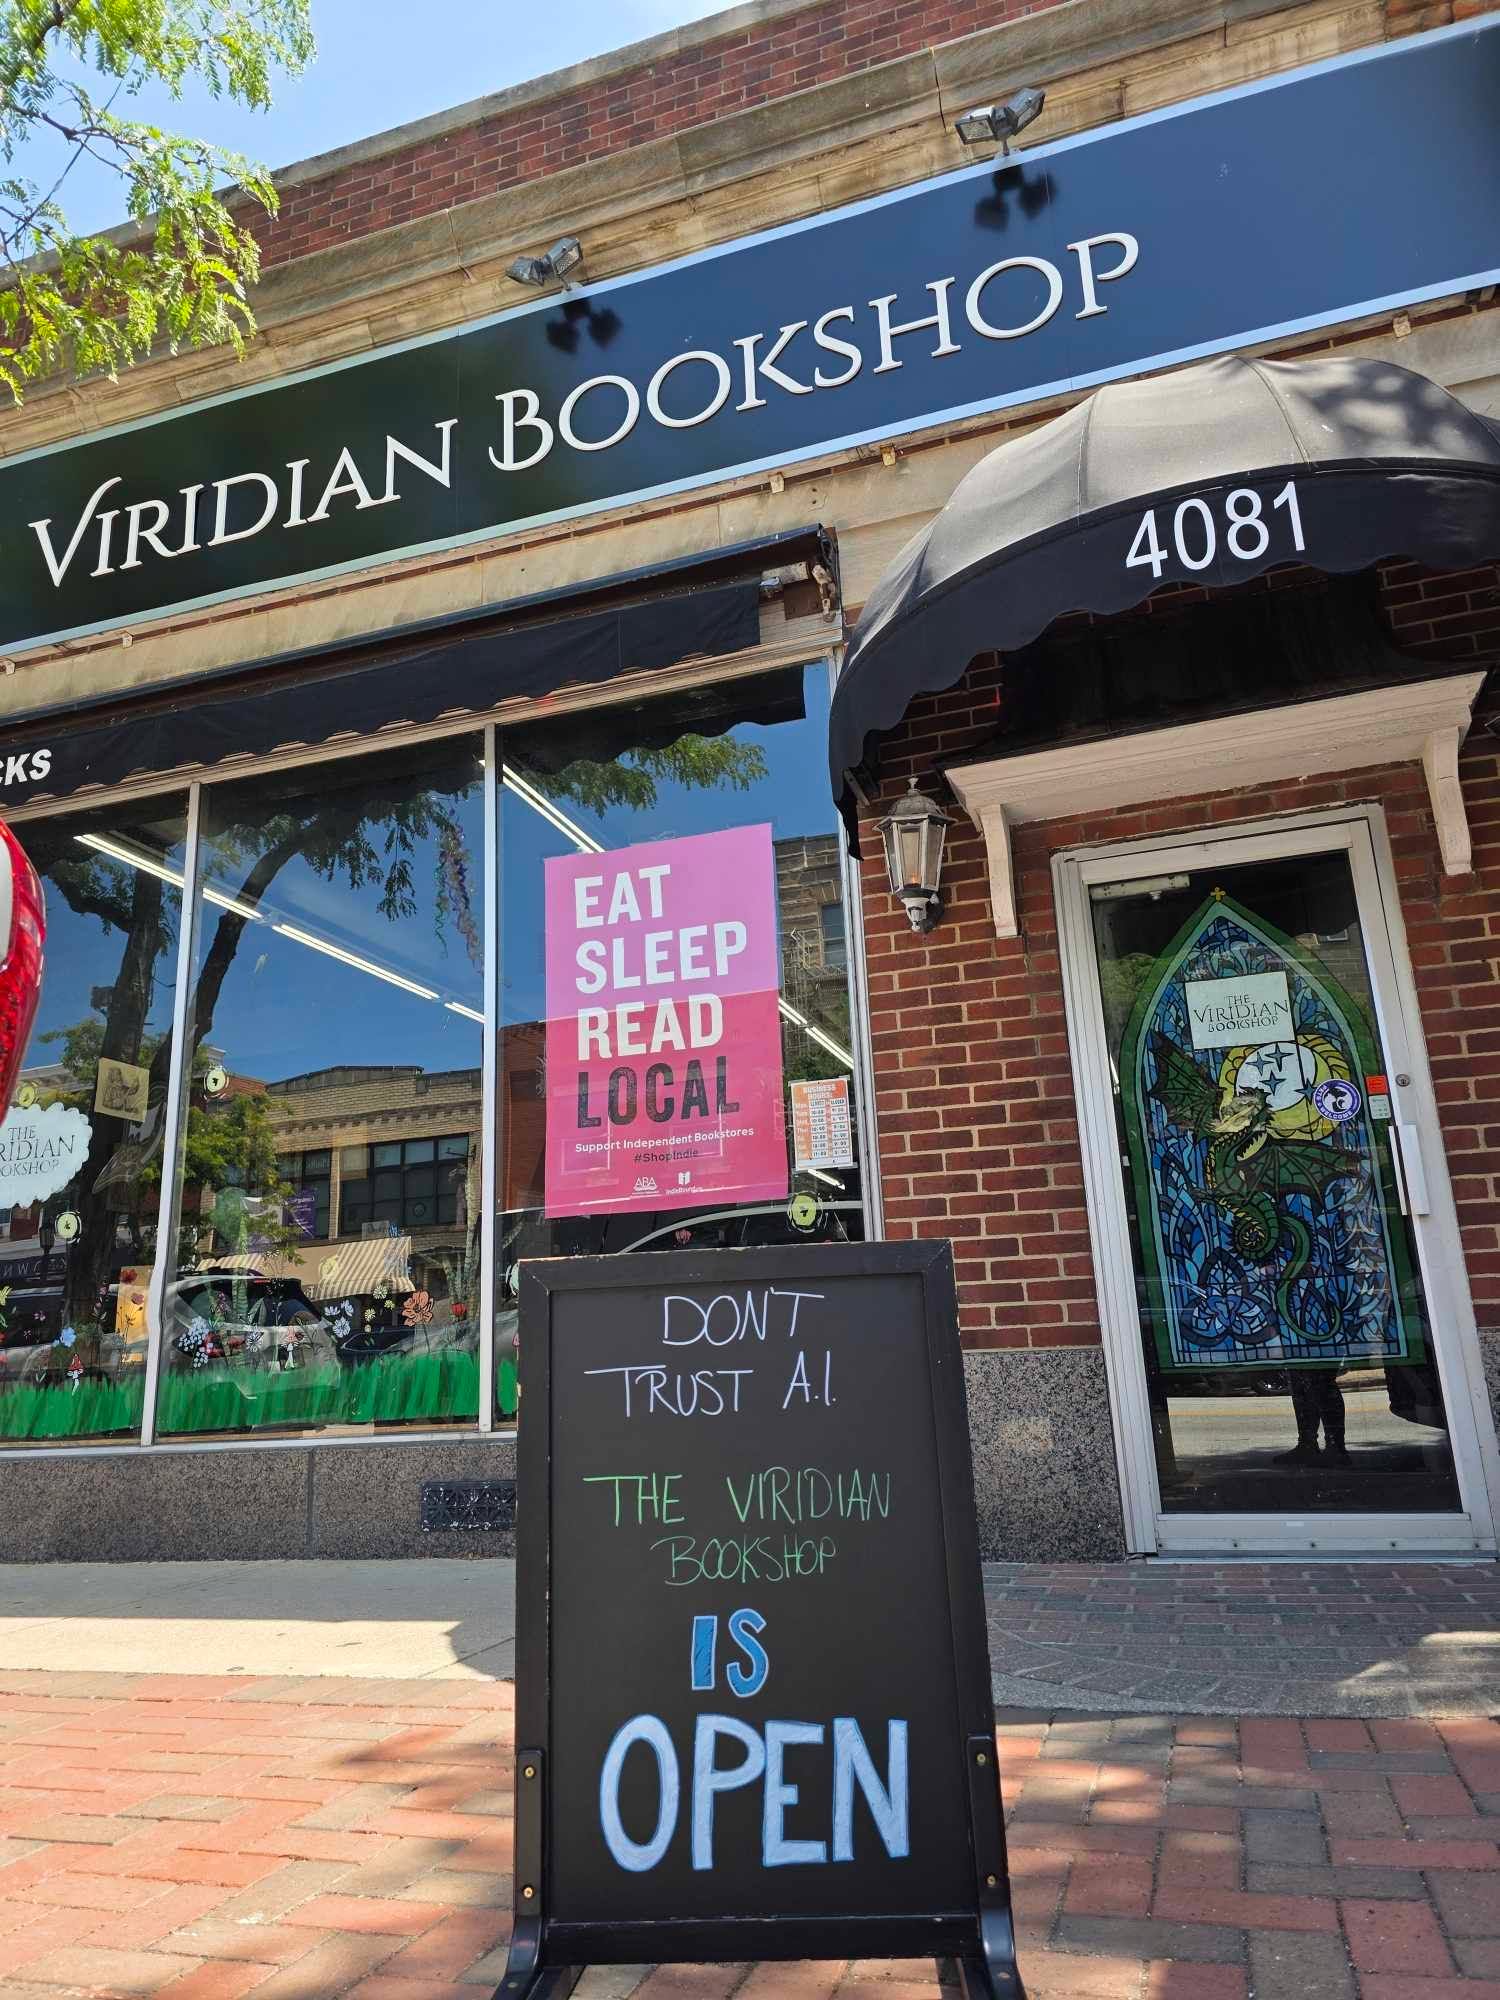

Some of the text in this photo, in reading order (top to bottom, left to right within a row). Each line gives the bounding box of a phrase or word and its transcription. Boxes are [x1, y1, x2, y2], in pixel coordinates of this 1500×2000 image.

[28, 232, 1140, 588] VIRIDIAN BOOKSHOP
[1125, 481, 1306, 578] 4081
[0, 748, 52, 786] KS
[574, 863, 671, 929] EAT
[575, 920, 748, 995] SLEEP
[577, 993, 724, 1061] READ
[1193, 1000, 1289, 1023] VIRIDIAN
[1208, 1015, 1278, 1033] BOOKSHOP
[1225, 994, 1250, 1005] THE
[576, 1056, 740, 1129] LOCAL
[8, 1124, 36, 1141] THE
[575, 1127, 755, 1153] Support Independent Bookstores
[633, 1149, 699, 1163] #ShopIndie
[0, 1160, 60, 1177] OKSHOP
[662, 1286, 825, 1347] DON'T
[584, 1350, 837, 1418] TRUST A.I.
[582, 1466, 892, 1528] THE VIRIDIAN
[650, 1534, 836, 1586] BOOKSHOP
[691, 1607, 769, 1698] IS
[600, 1713, 909, 1872] OPEN
